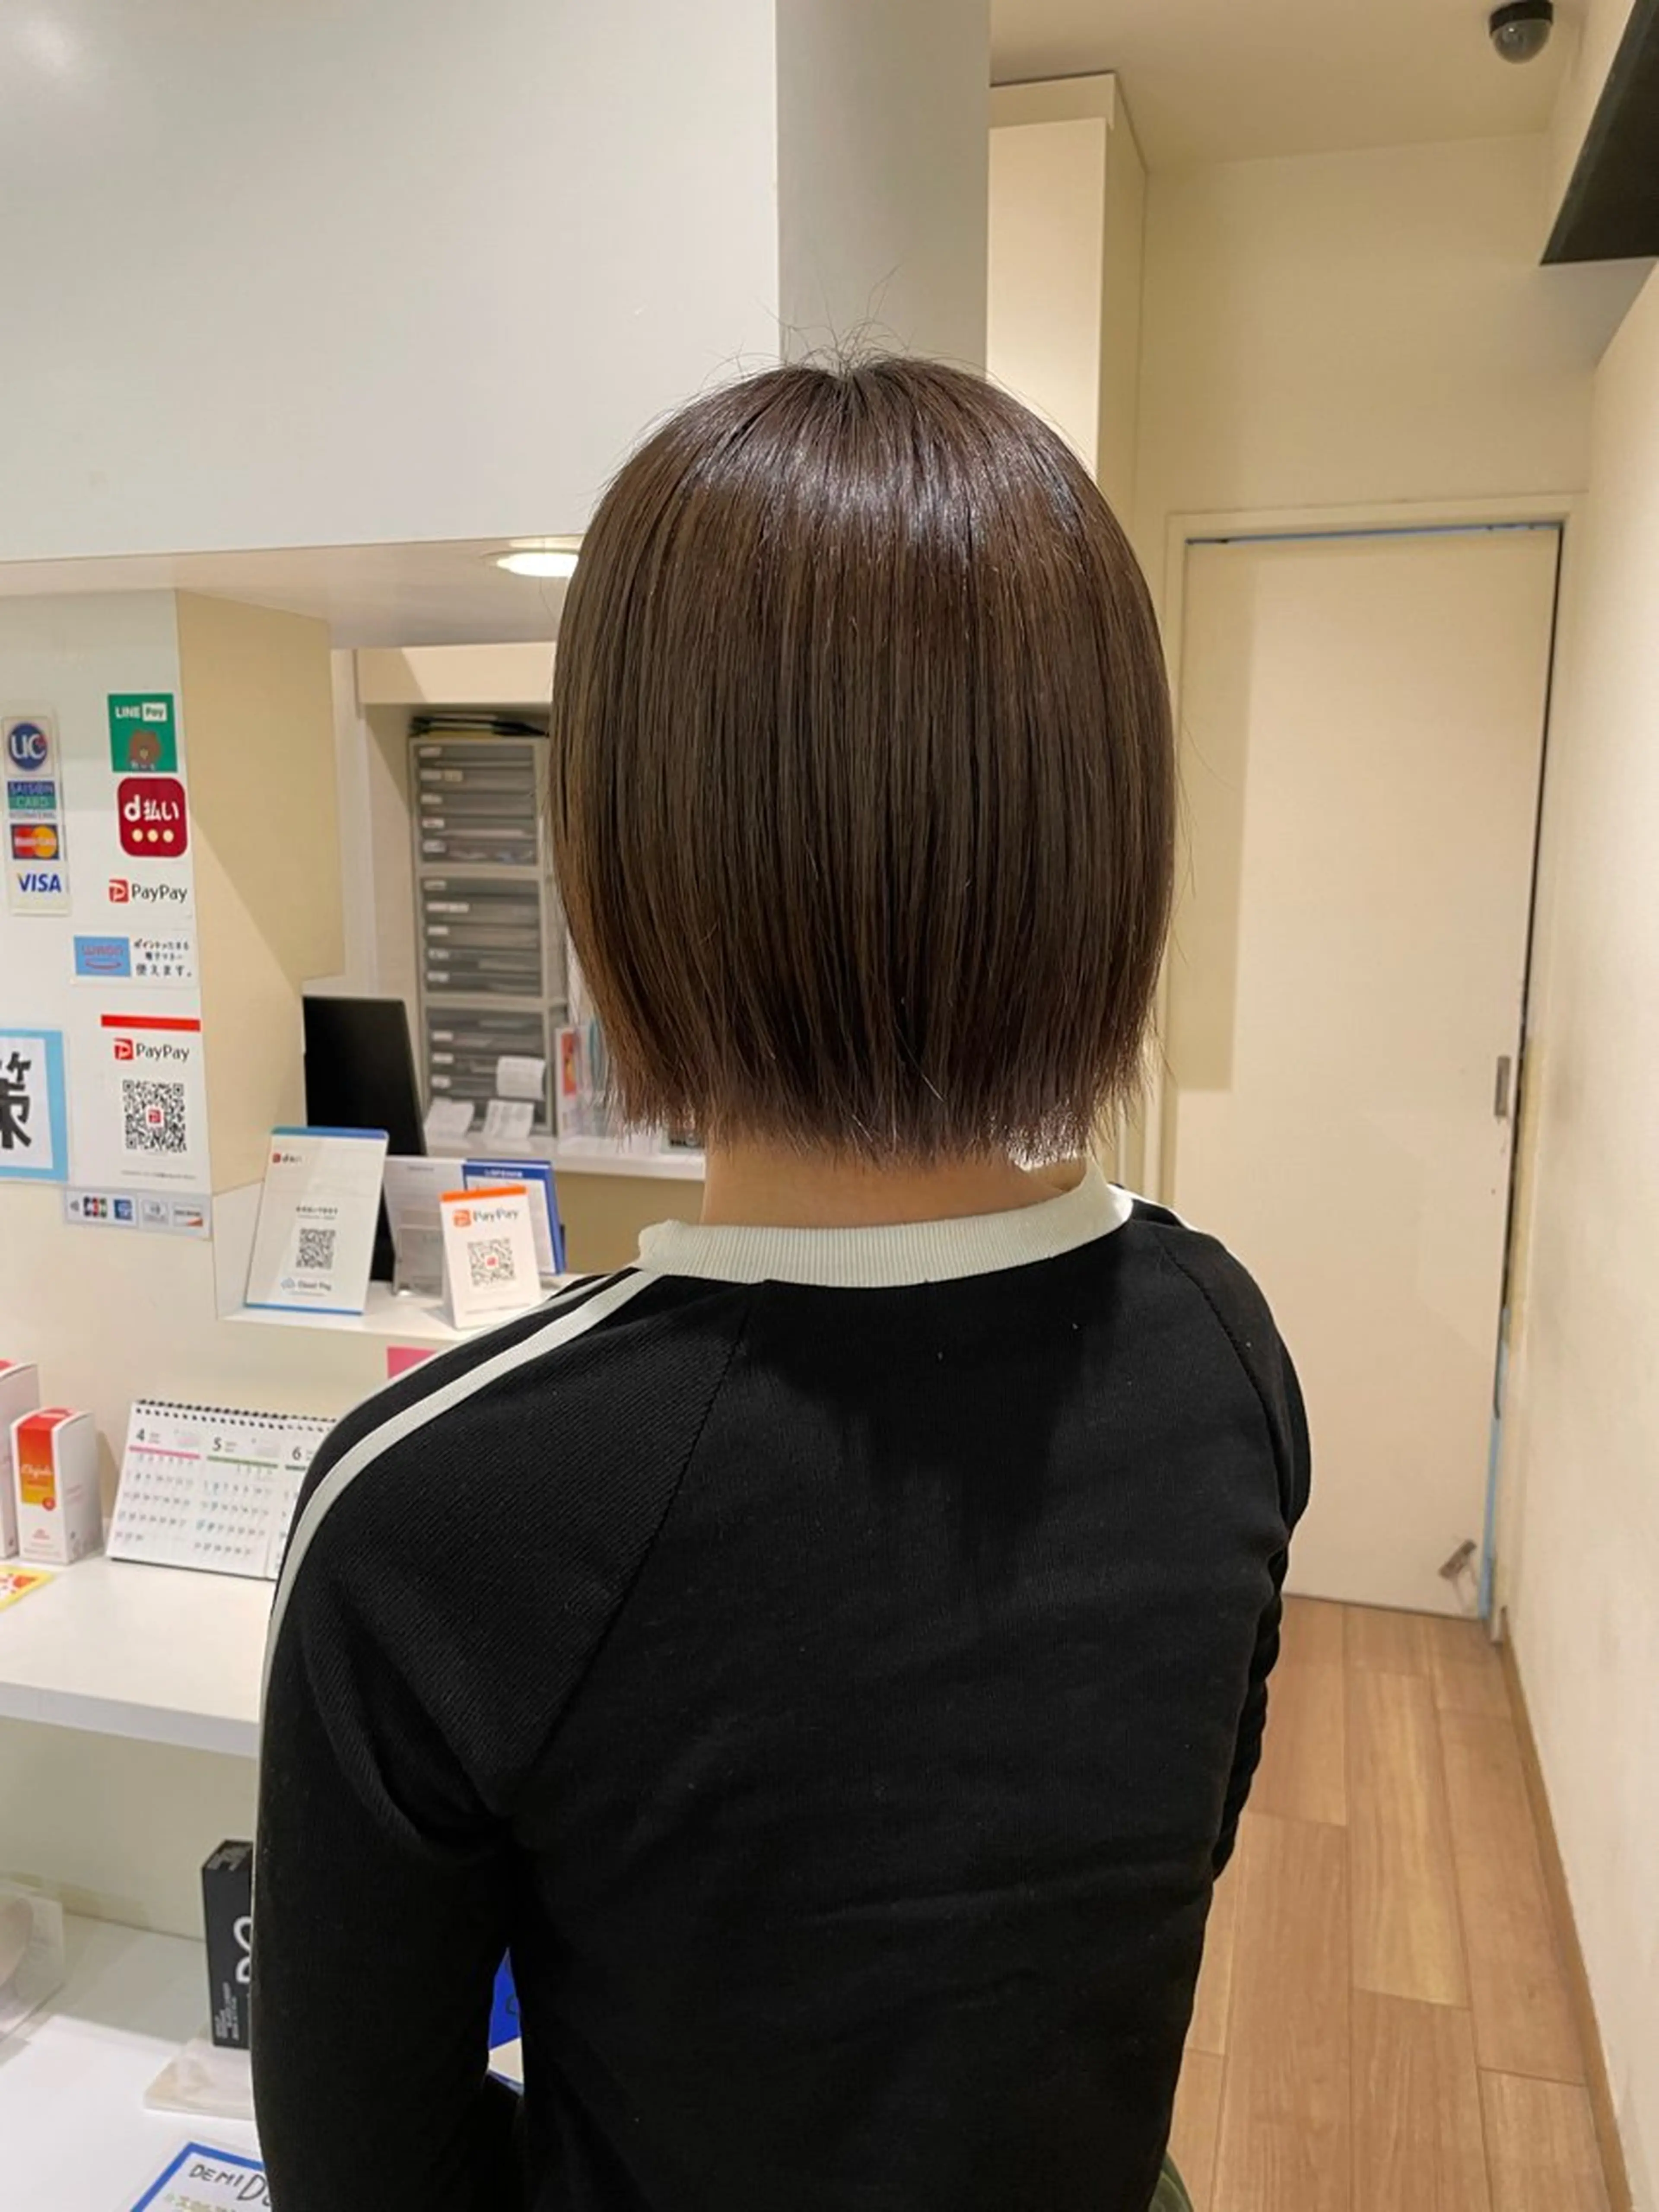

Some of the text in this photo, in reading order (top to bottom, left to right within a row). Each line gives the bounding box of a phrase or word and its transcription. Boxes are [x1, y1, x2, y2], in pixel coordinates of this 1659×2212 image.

[12, 734, 45, 759] UC
[18, 873, 61, 893] VISA
[132, 884, 187, 903] PayPay
[136, 1042, 190, 1063] PayPay
[136, 1427, 145, 1441] 4
[212, 1437, 222, 1452] 5
[292, 1446, 302, 1461] 6
[189, 2164, 245, 2187] DEMI
